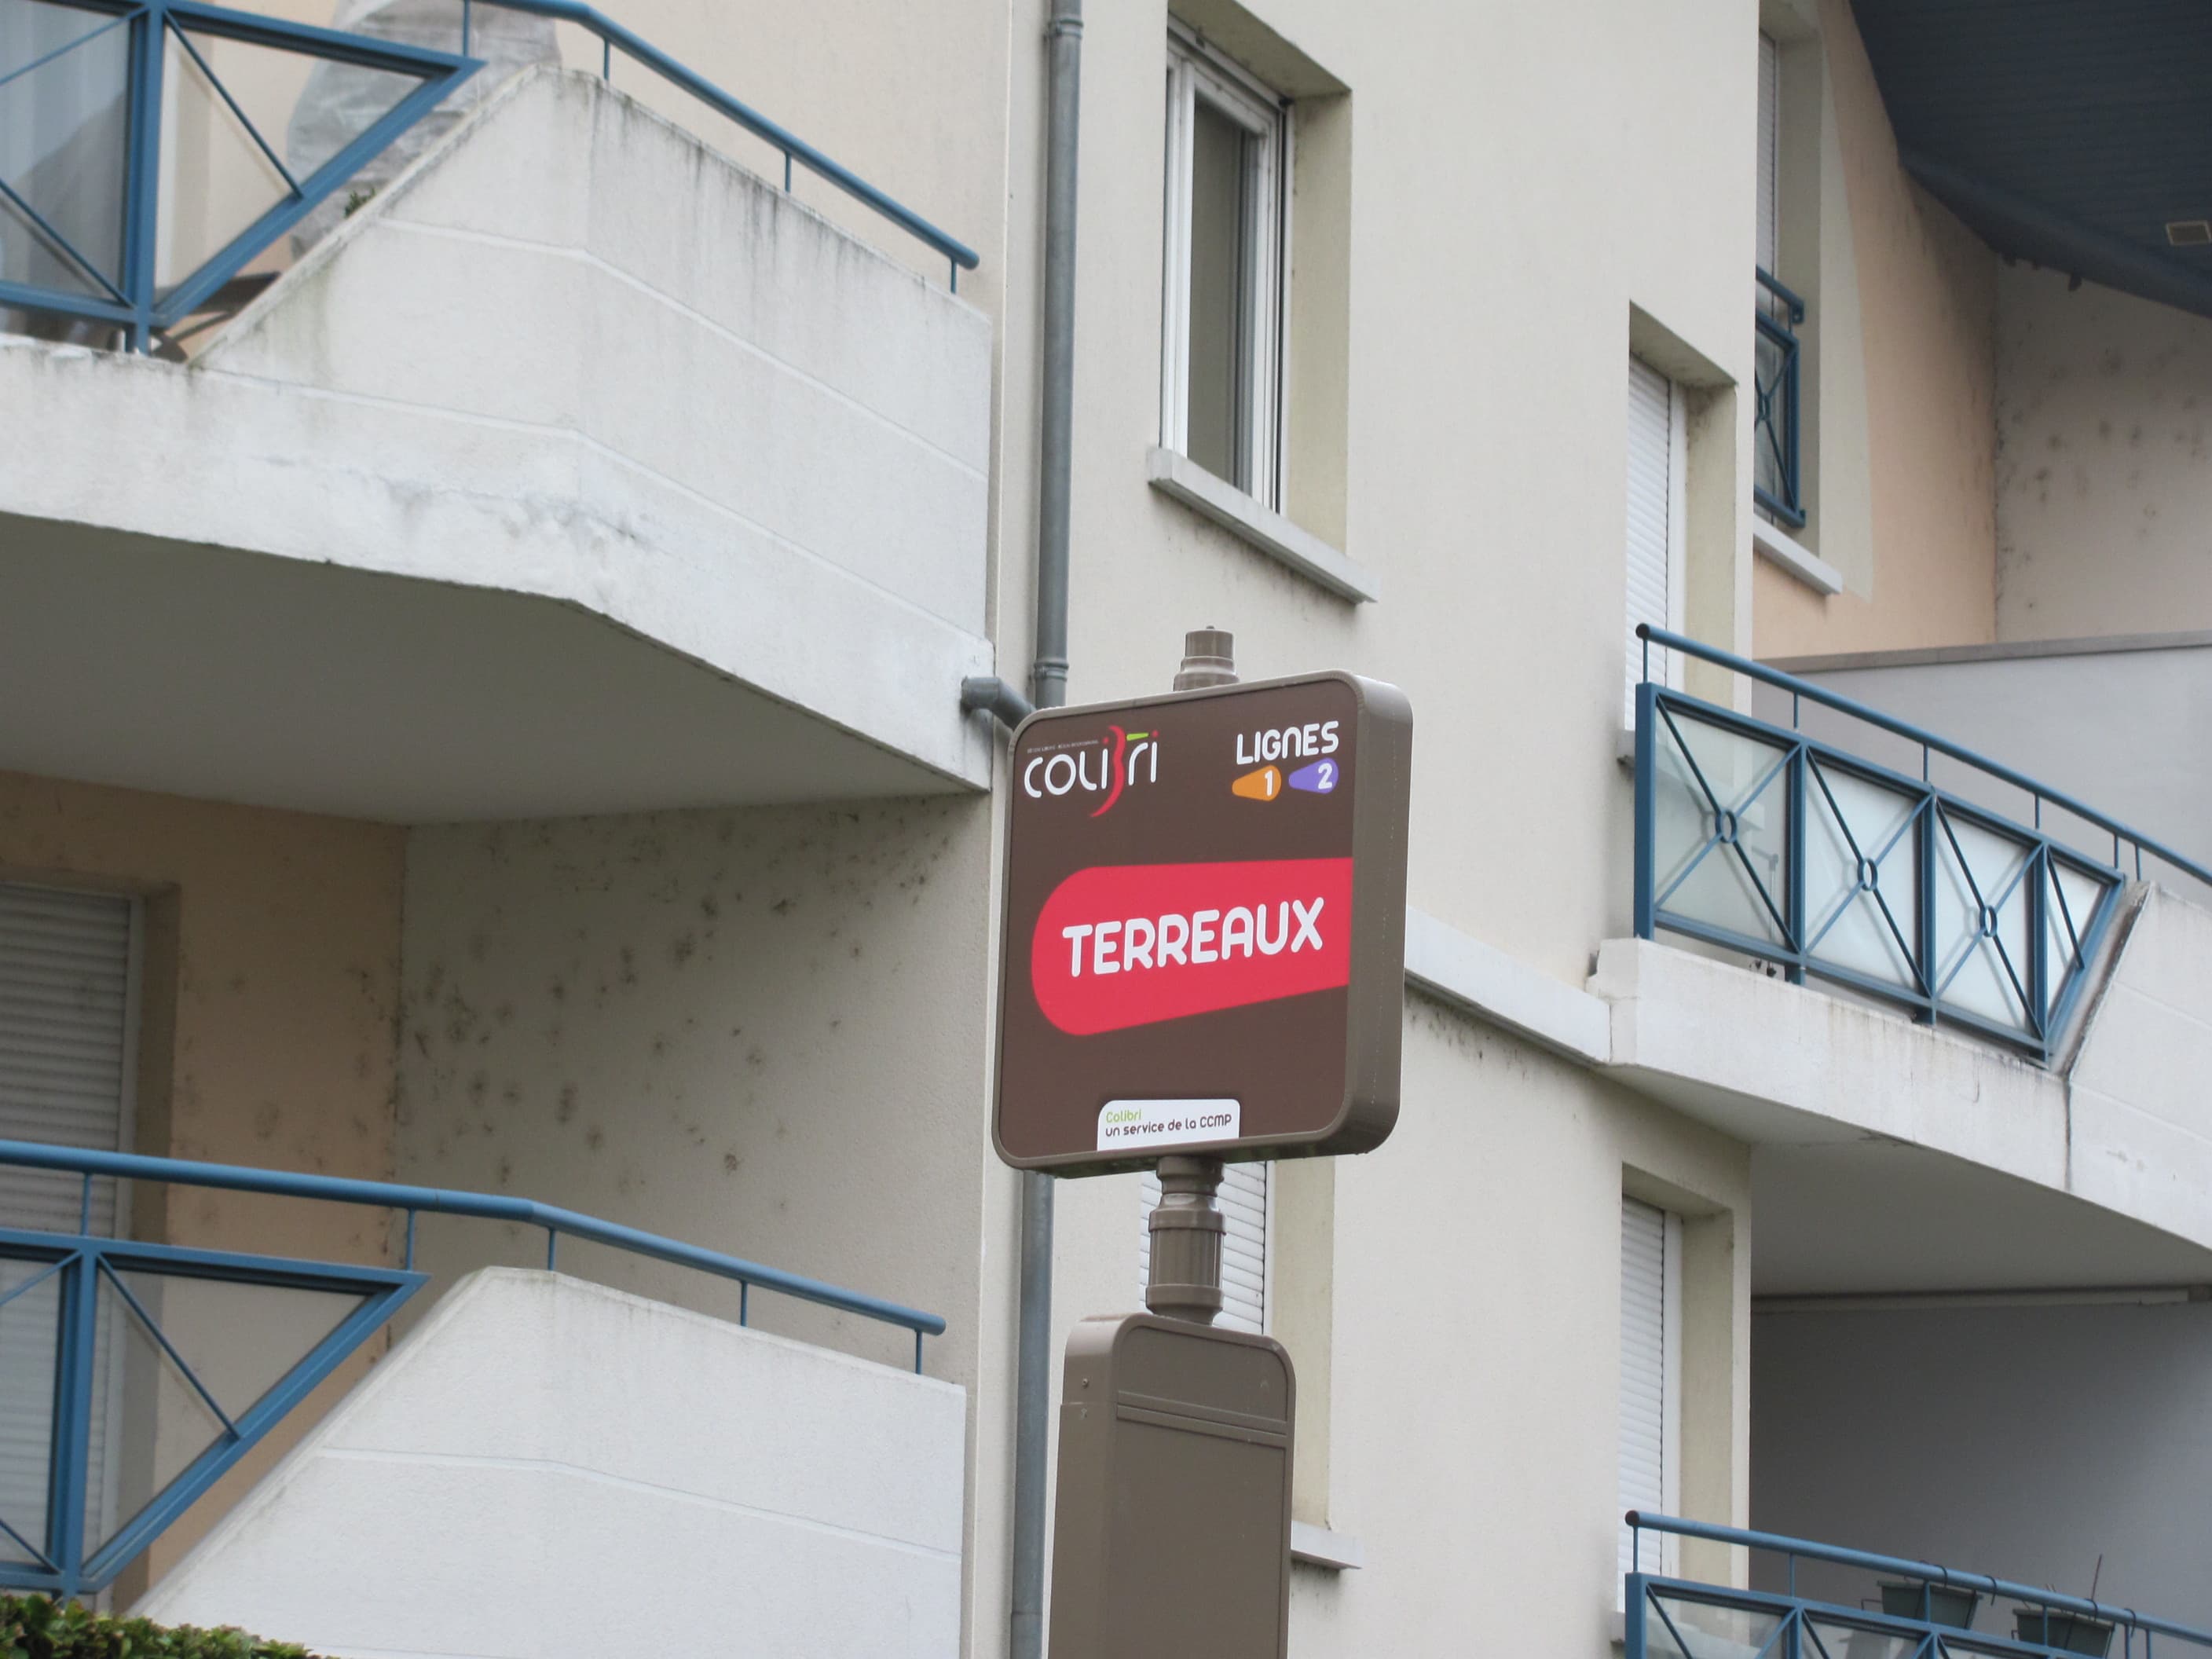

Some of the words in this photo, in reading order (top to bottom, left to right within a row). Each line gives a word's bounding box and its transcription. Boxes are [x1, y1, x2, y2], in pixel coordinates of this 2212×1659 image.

[1236, 720, 1339, 765] LIGNES
[1265, 770, 1273, 797] 1
[1317, 763, 1333, 789] 2
[1062, 897, 1324, 977] TERREAUX
[1105, 1126, 1120, 1137] un
[1123, 1121, 1165, 1136] service
[1167, 1119, 1182, 1132] de
[1185, 1118, 1196, 1130] la
[1106, 1109, 1141, 1122] Colibri
